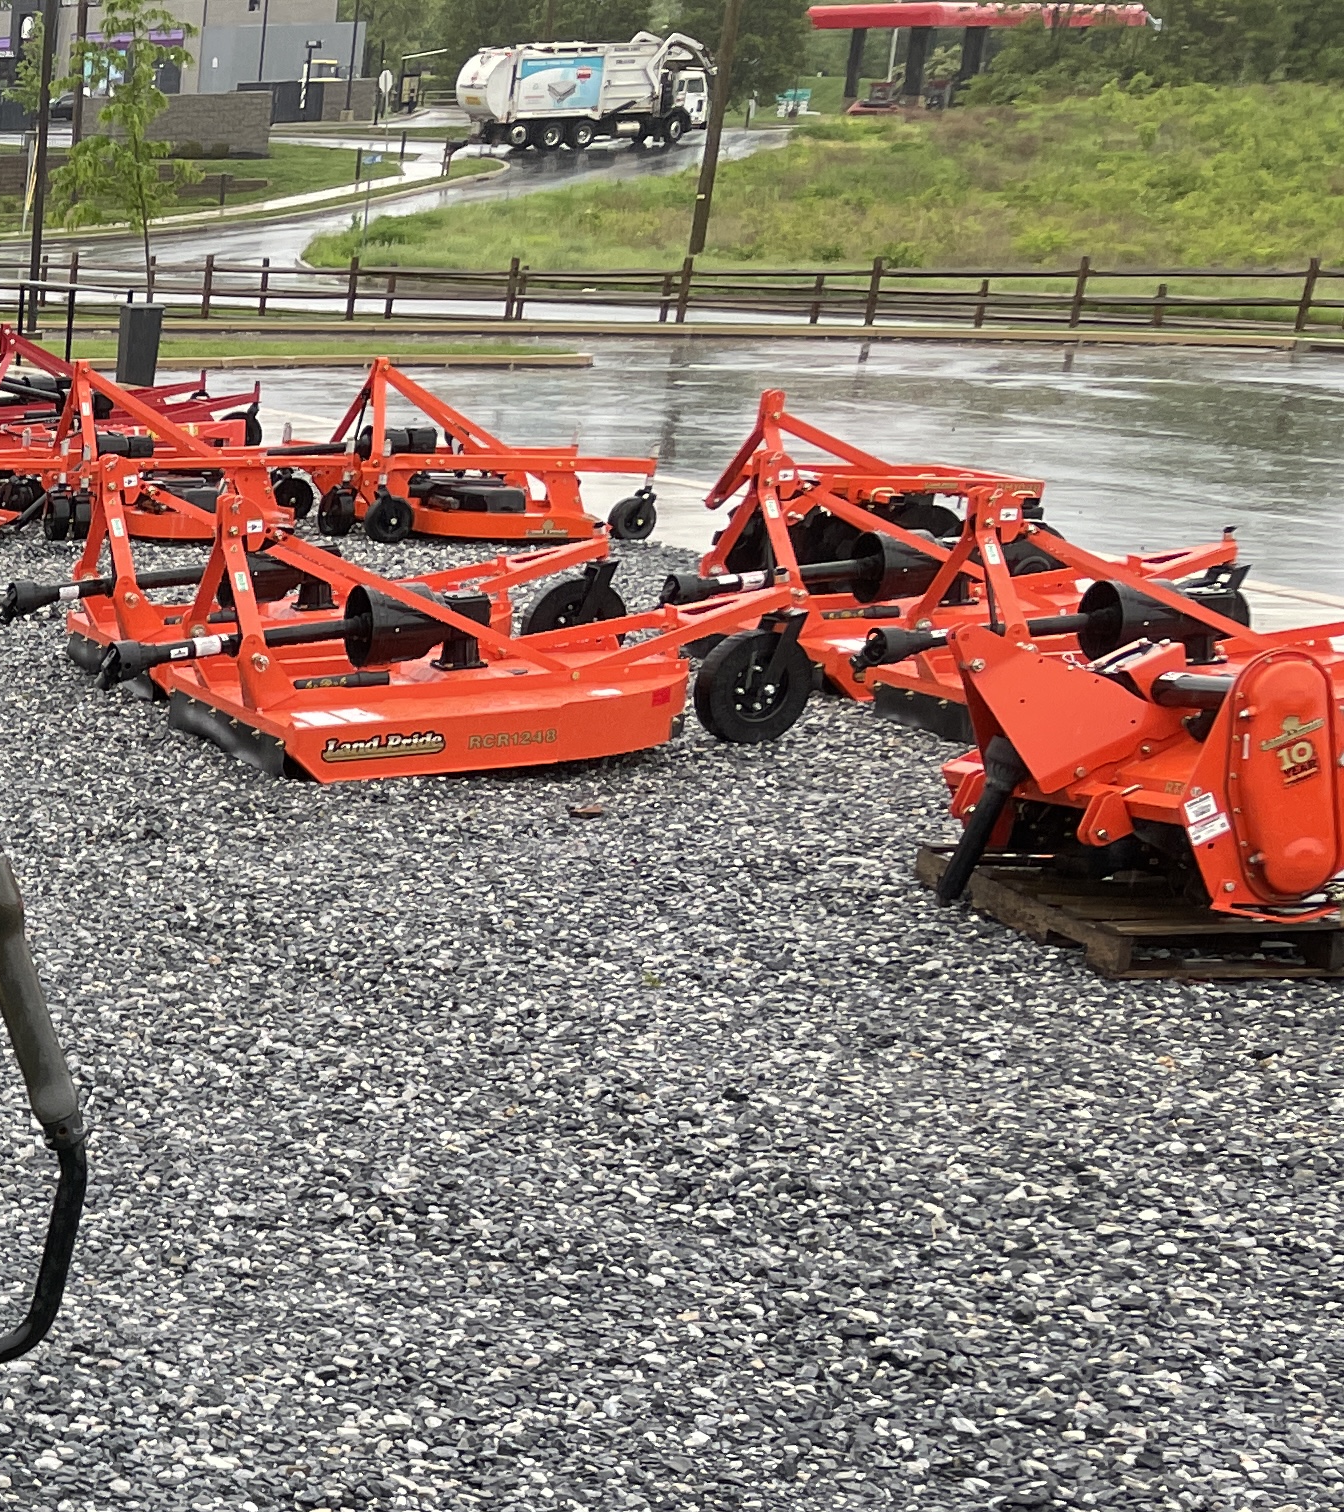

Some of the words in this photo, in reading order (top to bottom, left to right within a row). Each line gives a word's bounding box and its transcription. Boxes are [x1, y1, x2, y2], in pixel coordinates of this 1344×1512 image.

[324, 735, 382, 755] Land
[386, 730, 444, 750] Pride
[468, 728, 558, 750] RCR1248
[1275, 741, 1313, 771] 10
